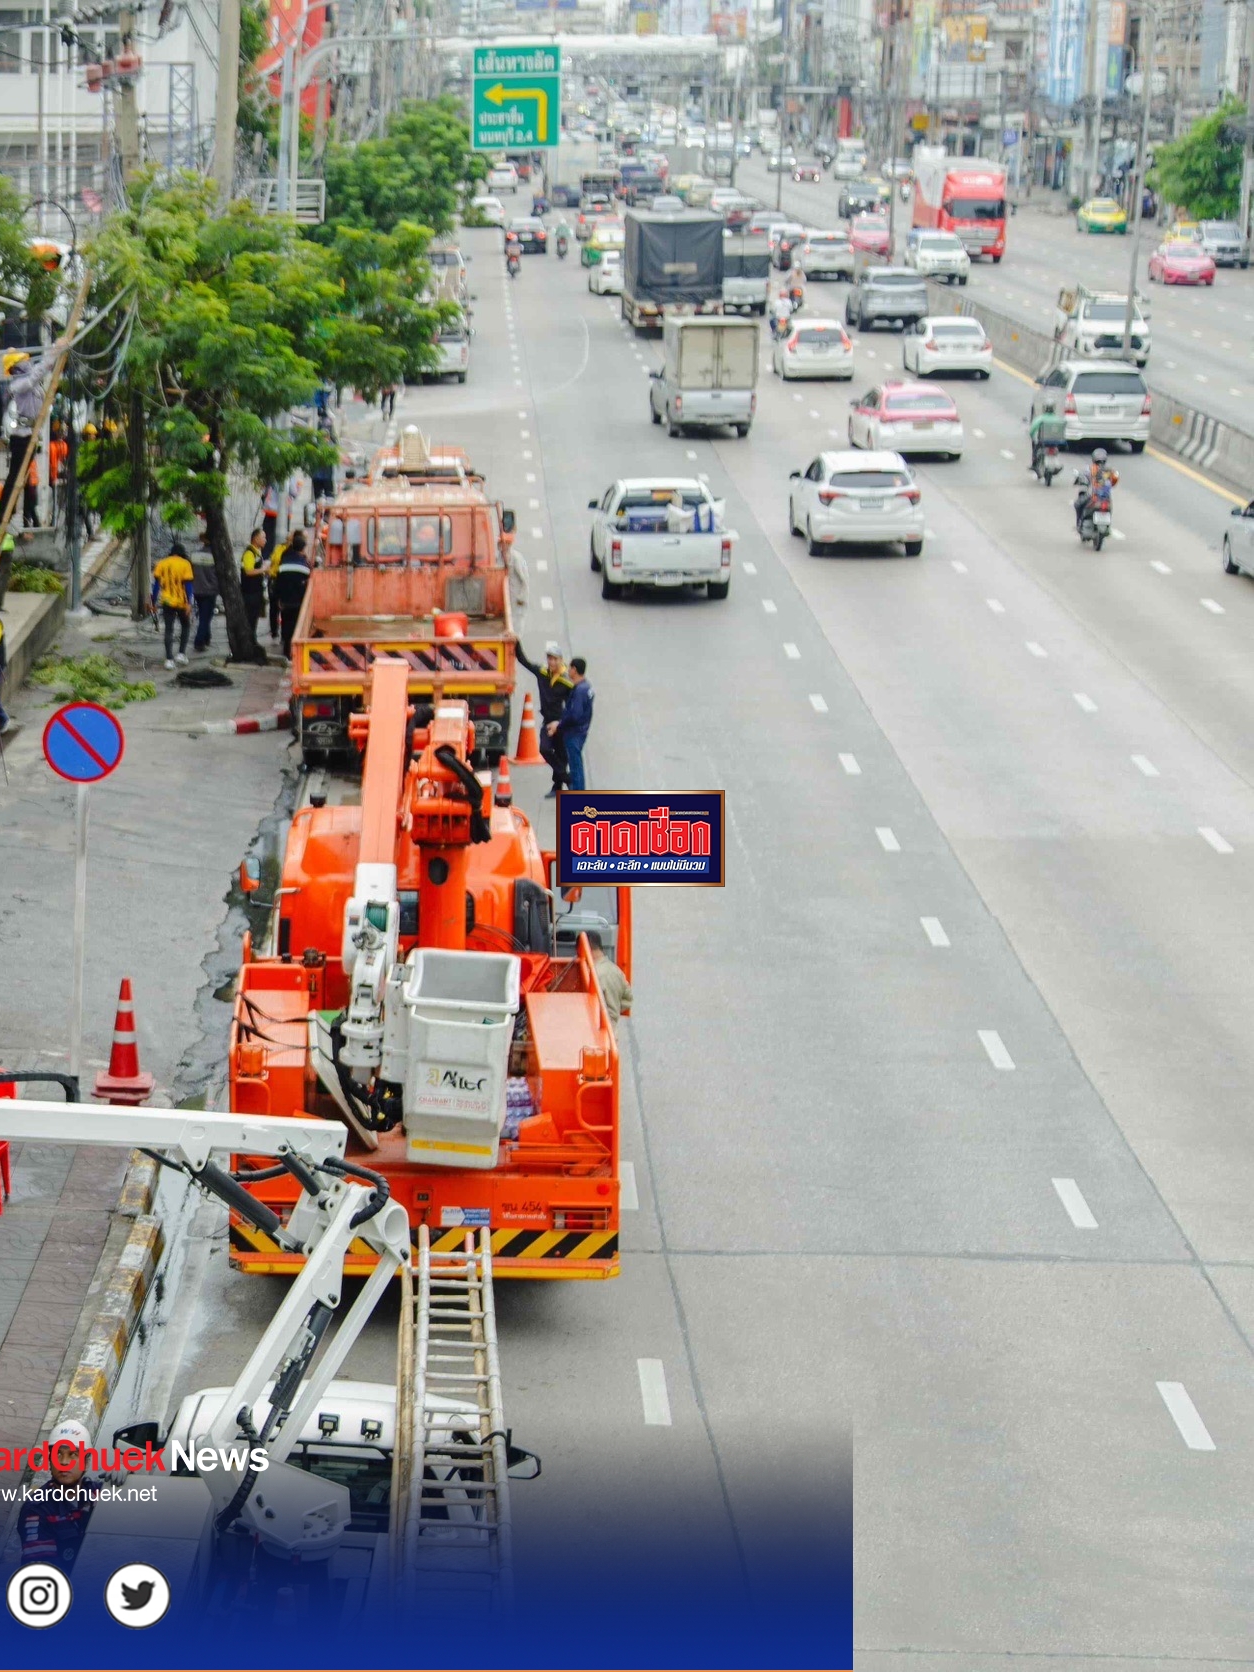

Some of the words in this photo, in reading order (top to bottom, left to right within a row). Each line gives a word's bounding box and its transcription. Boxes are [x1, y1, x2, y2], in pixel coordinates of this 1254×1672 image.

[477, 49, 555, 73] เส้นทางลัด
[522, 1200, 543, 1212] 454
